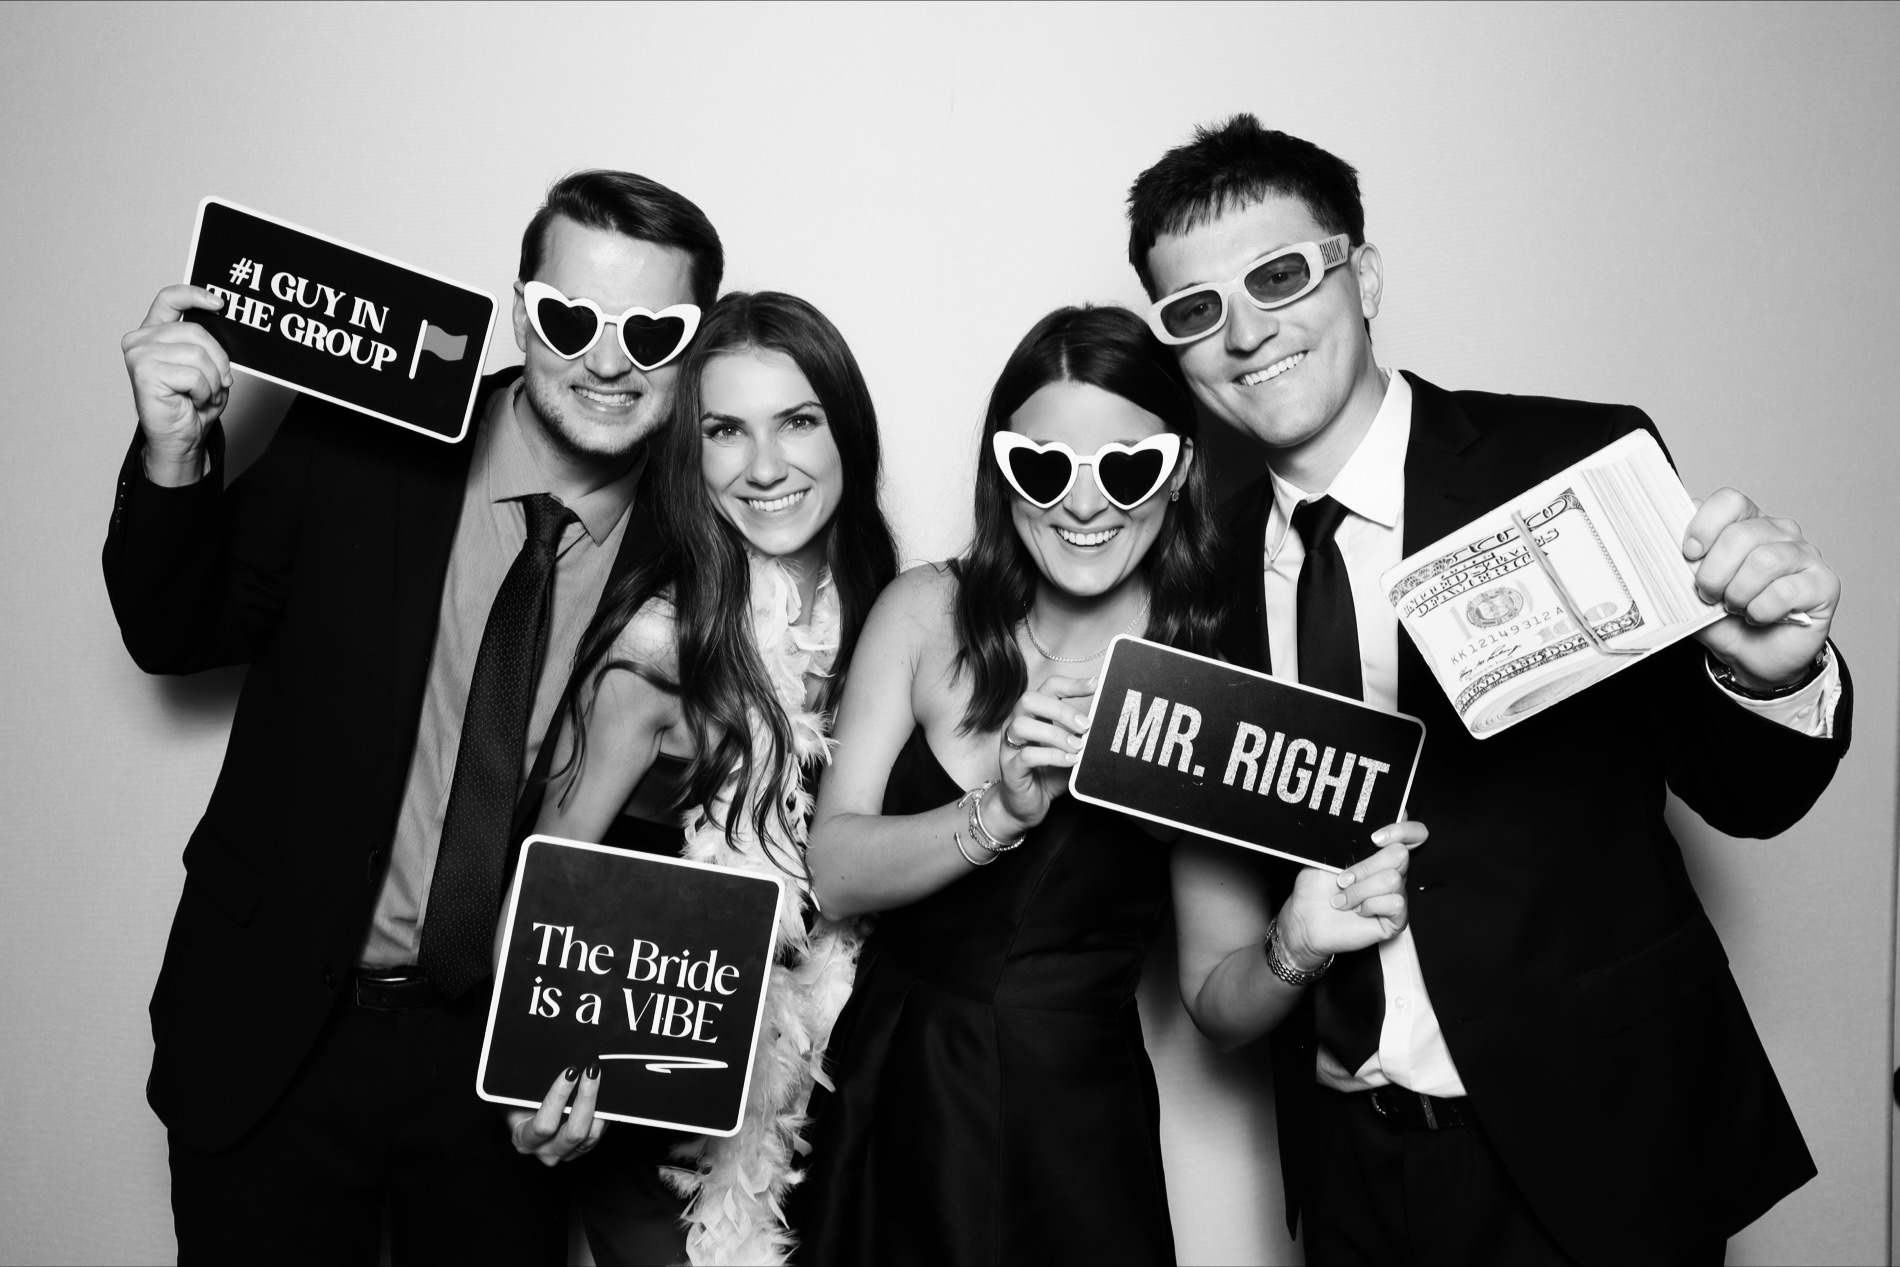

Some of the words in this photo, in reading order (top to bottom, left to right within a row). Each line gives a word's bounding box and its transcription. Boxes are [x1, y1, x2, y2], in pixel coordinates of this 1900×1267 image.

[205, 283, 275, 333] THE
[279, 313, 398, 372] GROUP
[229, 257, 264, 292] #1
[270, 271, 347, 318] GUY
[349, 296, 390, 334] IN
[1439, 552, 1549, 604] AMERIC
[1109, 687, 1206, 778] MR.
[1222, 720, 1391, 824] RIGHT
[532, 922, 615, 975] The
[626, 938, 740, 996] Bride
[528, 975, 563, 1018] is
[575, 993, 602, 1026] a
[622, 987, 724, 1044] VIBE
